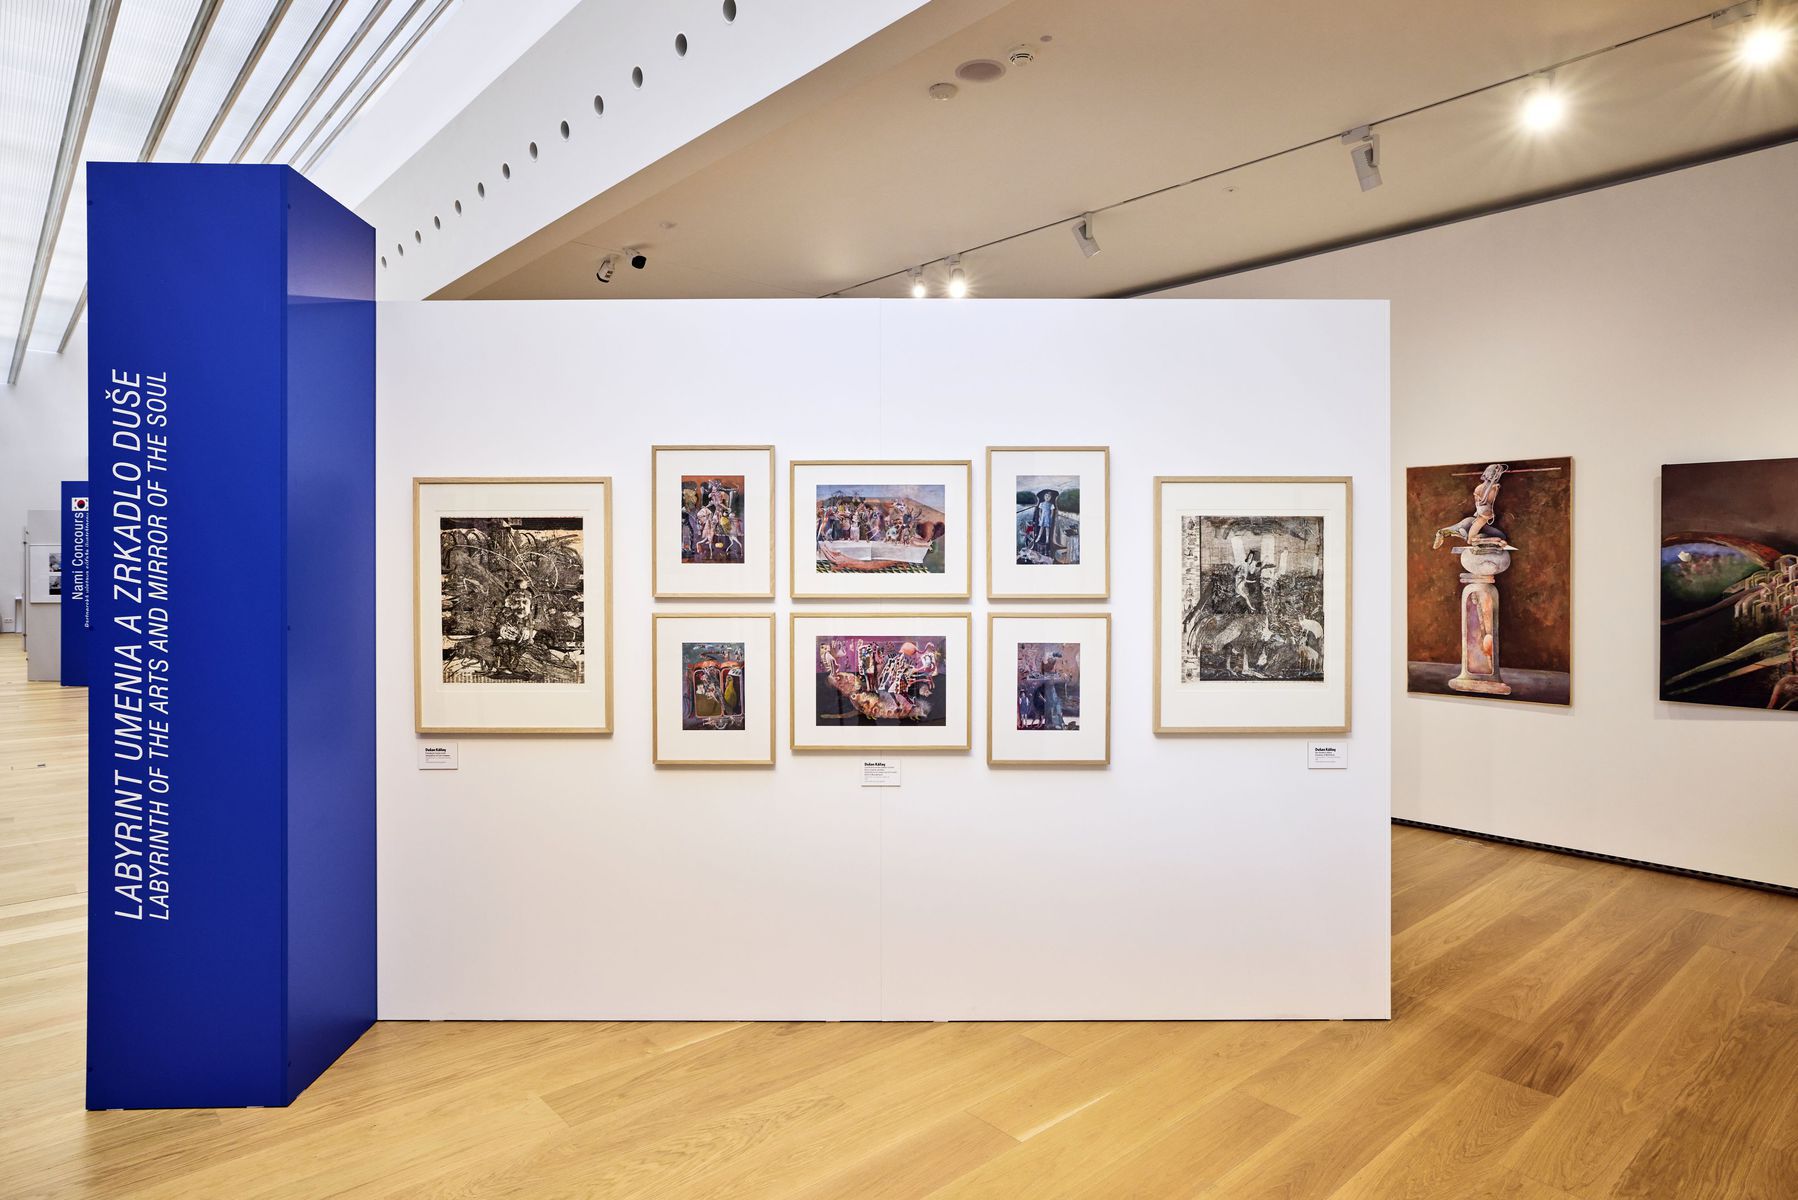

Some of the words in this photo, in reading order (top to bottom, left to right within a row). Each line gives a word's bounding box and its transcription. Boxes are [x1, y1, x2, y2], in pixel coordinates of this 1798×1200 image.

[105, 368, 141, 452] DUŠE
[146, 371, 168, 428] SOUL
[146, 433, 168, 473] THE
[147, 479, 168, 507] OF
[71, 511, 84, 567] Concours
[112, 461, 142, 604] ZRKADLO
[147, 514, 168, 601] MIRROR
[71, 570, 84, 600] Nami
[113, 616, 142, 635] A
[148, 607, 169, 654] AND
[114, 645, 144, 761] UMENIA
[148, 659, 169, 715] ARTS
[148, 719, 169, 759] THE
[148, 767, 170, 794] OF
[114, 770, 144, 920] LABYRINT
[148, 801, 170, 921] LABYRINTH
